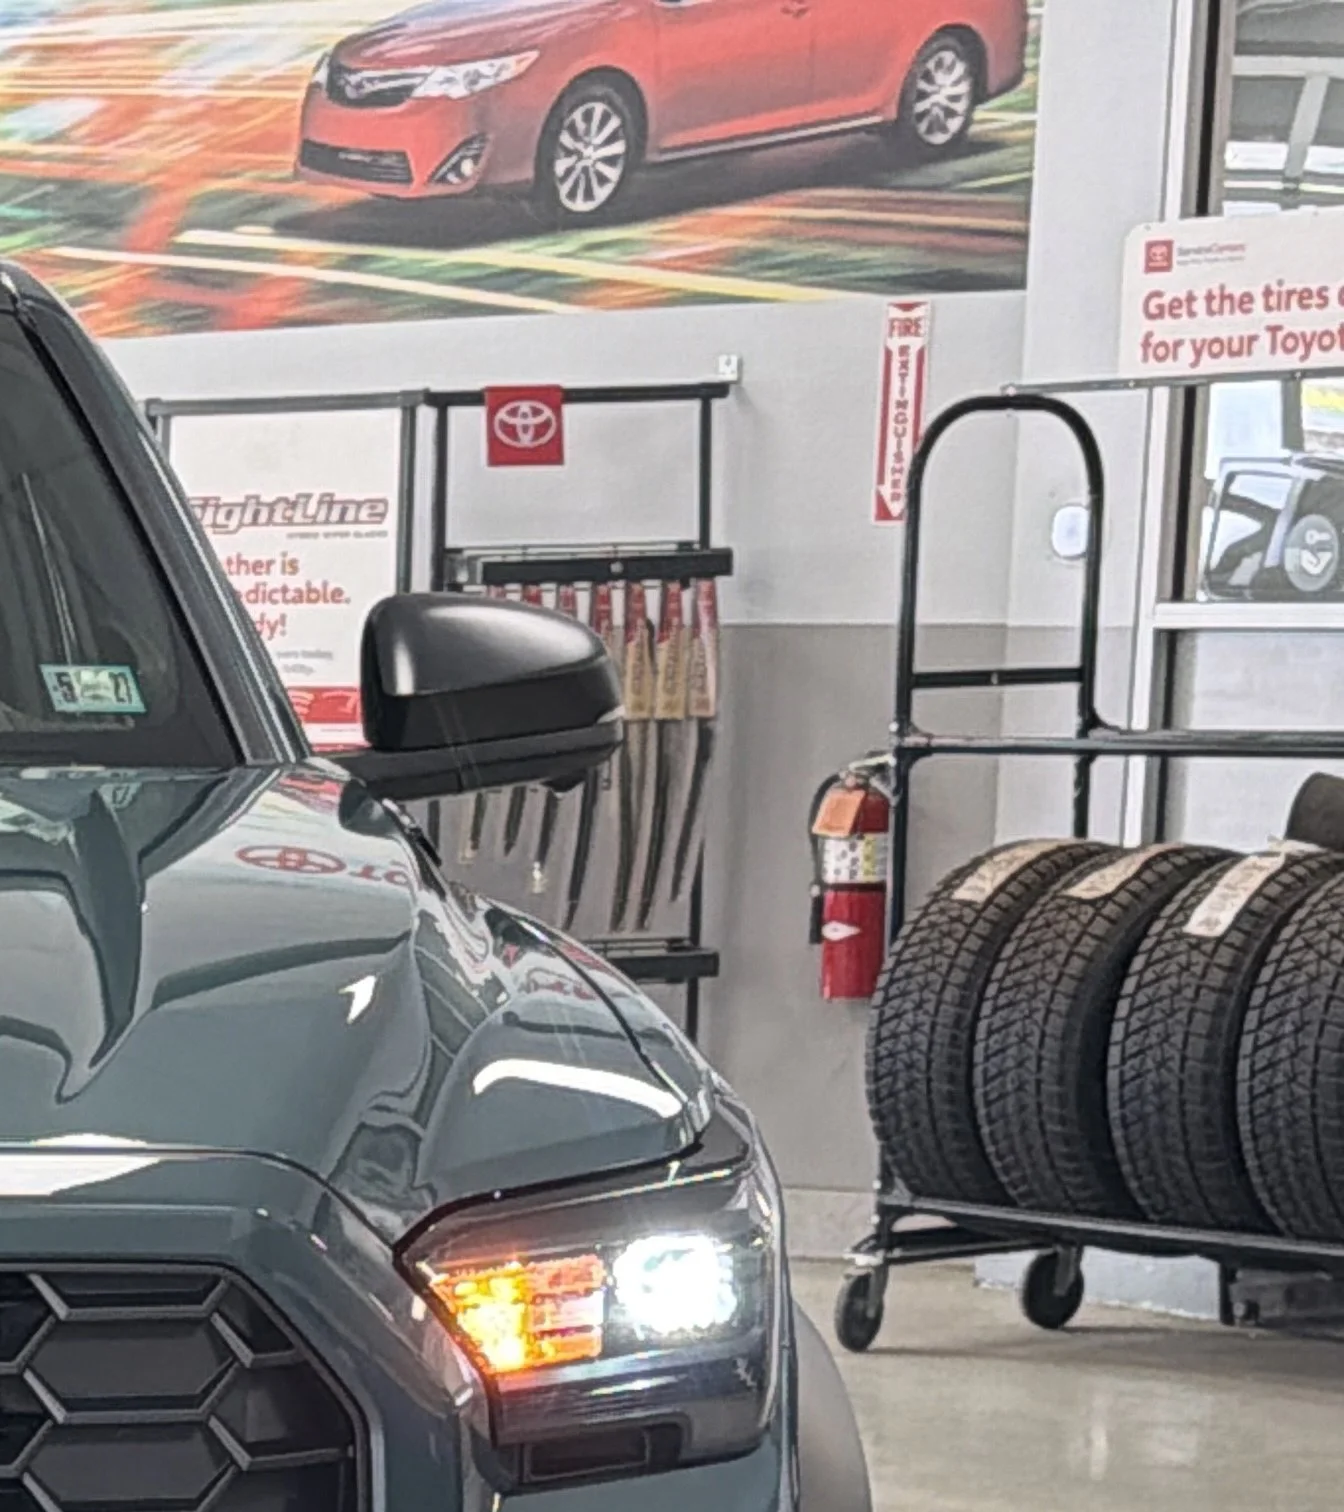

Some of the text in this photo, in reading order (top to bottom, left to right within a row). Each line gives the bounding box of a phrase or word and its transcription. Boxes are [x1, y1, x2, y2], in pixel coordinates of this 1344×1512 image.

[1142, 289, 1199, 321] Get
[1204, 283, 1255, 317] the
[1262, 278, 1329, 314] tires
[888, 317, 925, 338] FIRE
[1140, 330, 1185, 364] for
[1189, 333, 1260, 369] your
[890, 344, 911, 502] EXTINGUISHER
[225, 551, 300, 576] ther is
[255, 612, 288, 641] dy!
